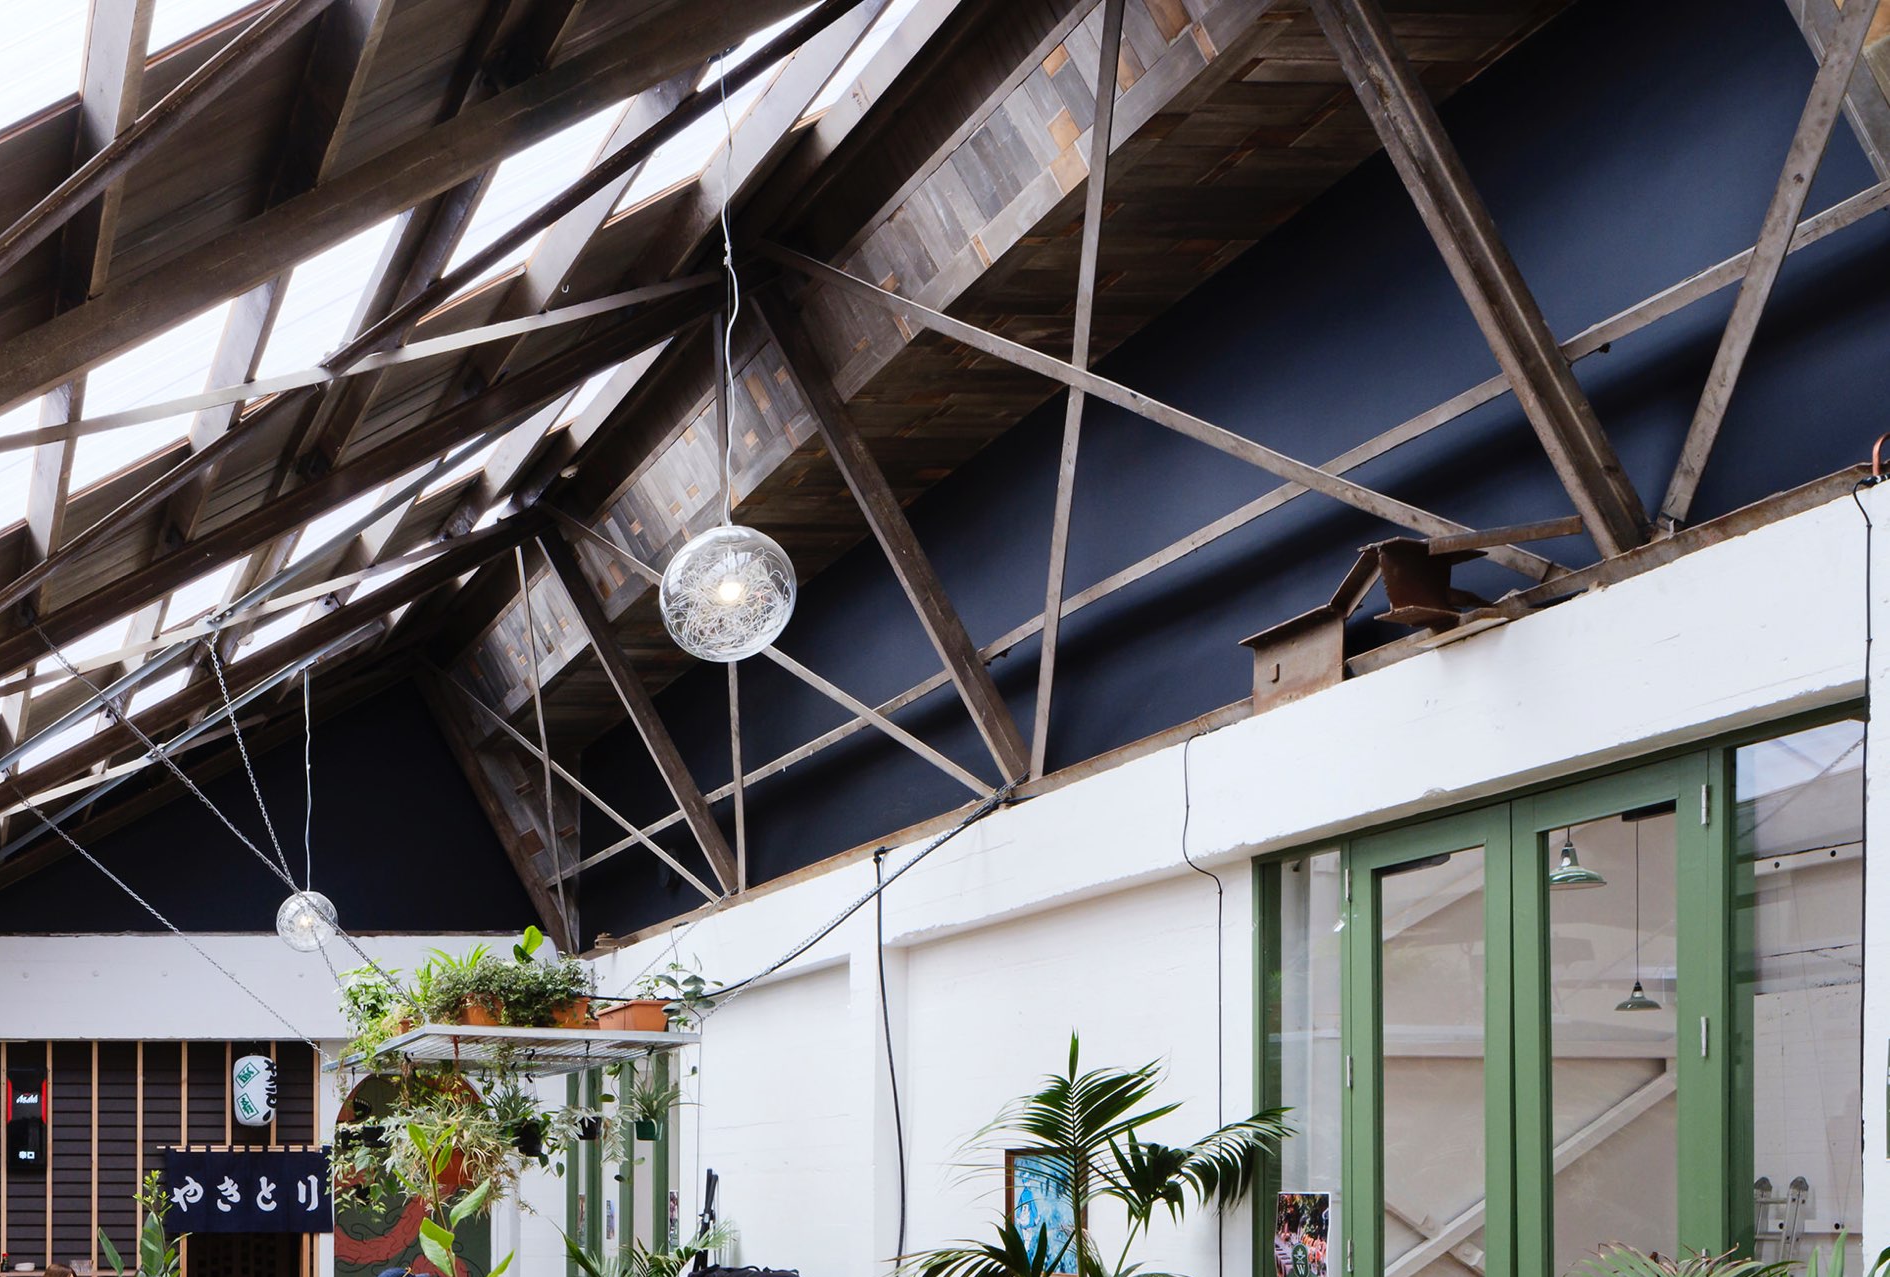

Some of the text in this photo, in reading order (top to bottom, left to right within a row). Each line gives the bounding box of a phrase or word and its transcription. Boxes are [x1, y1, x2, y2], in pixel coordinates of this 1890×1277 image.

[170, 1174, 319, 1213] やきとり
[1295, 1263, 1306, 1276] W
